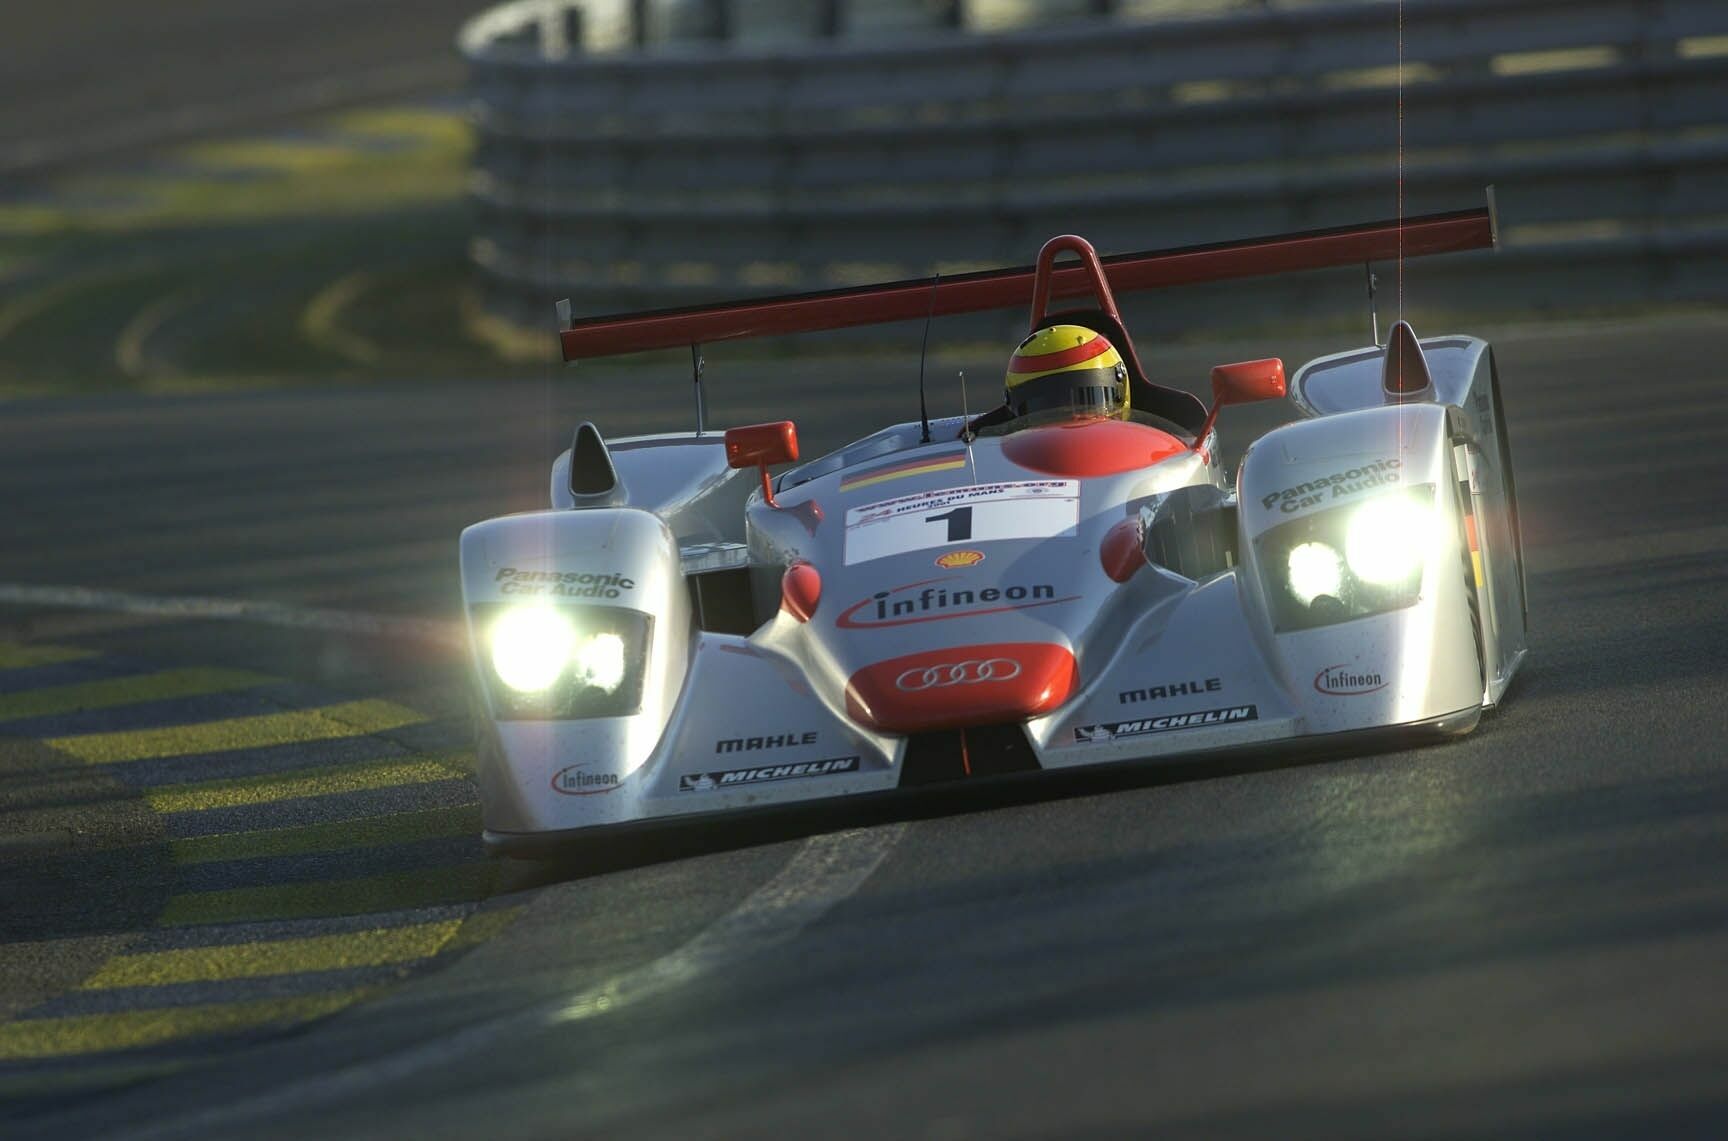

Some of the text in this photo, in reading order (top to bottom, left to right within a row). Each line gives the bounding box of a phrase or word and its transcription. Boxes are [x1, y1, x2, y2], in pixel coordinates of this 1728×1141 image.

[1262, 459, 1403, 511] Panasonic
[1280, 472, 1400, 514] Car Audio
[897, 499, 943, 513] HEURES
[947, 494, 965, 502] DU
[968, 489, 1005, 499] MANS
[925, 506, 973, 542] 1
[496, 567, 636, 589] Panasonic
[502, 582, 621, 599] Car Audio
[874, 584, 1055, 619] infineon
[1119, 678, 1222, 704] MAHLE
[1116, 706, 1250, 734] MICHELIN
[716, 732, 818, 754] MAHLE
[720, 759, 853, 784] MICHELIN
